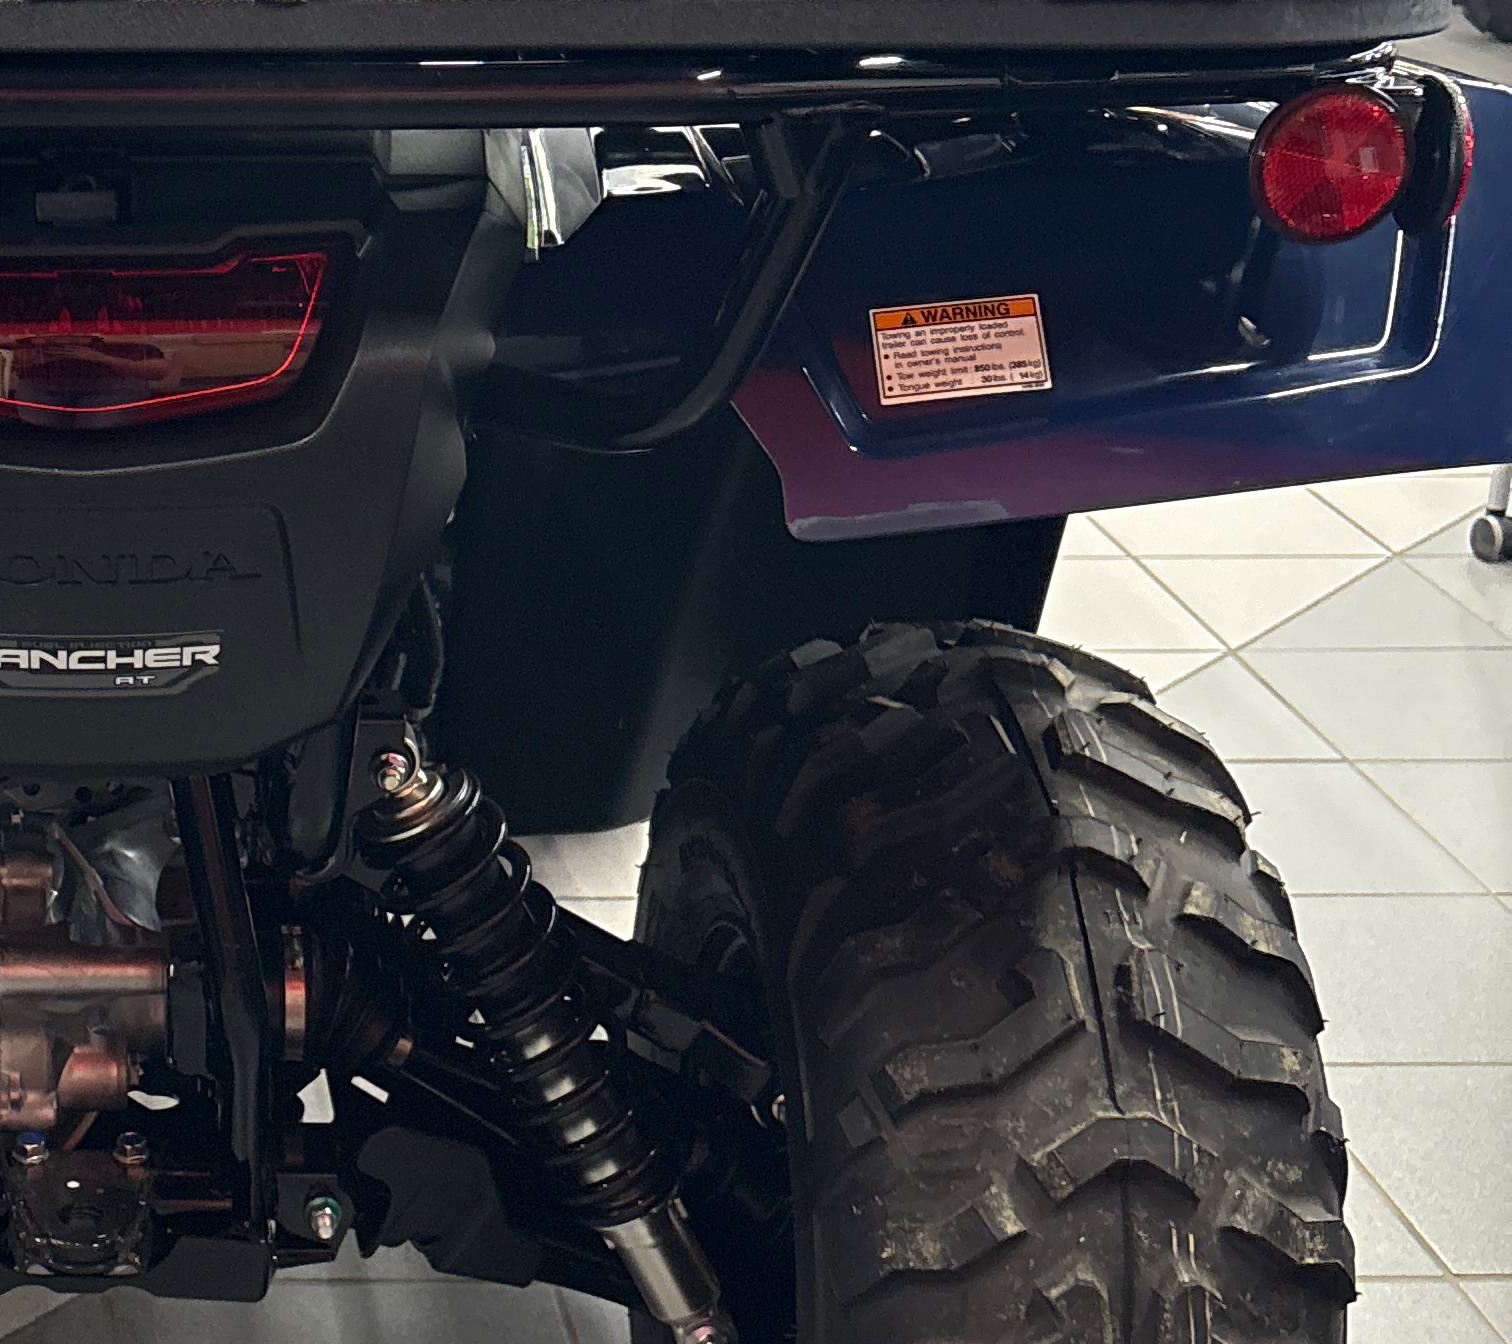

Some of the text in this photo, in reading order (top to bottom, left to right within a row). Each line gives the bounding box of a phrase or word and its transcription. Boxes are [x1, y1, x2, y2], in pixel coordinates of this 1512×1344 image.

[920, 302, 1011, 323] WARNING
[881, 321, 1008, 342] Towing an improperly loaded
[881, 328, 1024, 350] trailer can cause loss of control
[893, 342, 1003, 360] Read towing instructions
[894, 353, 977, 369] in owner's manual
[896, 371, 914, 381] Tow
[918, 368, 947, 380] weight
[898, 381, 931, 393] Tongue
[934, 378, 963, 390] weight
[115, 675, 156, 686] AT
